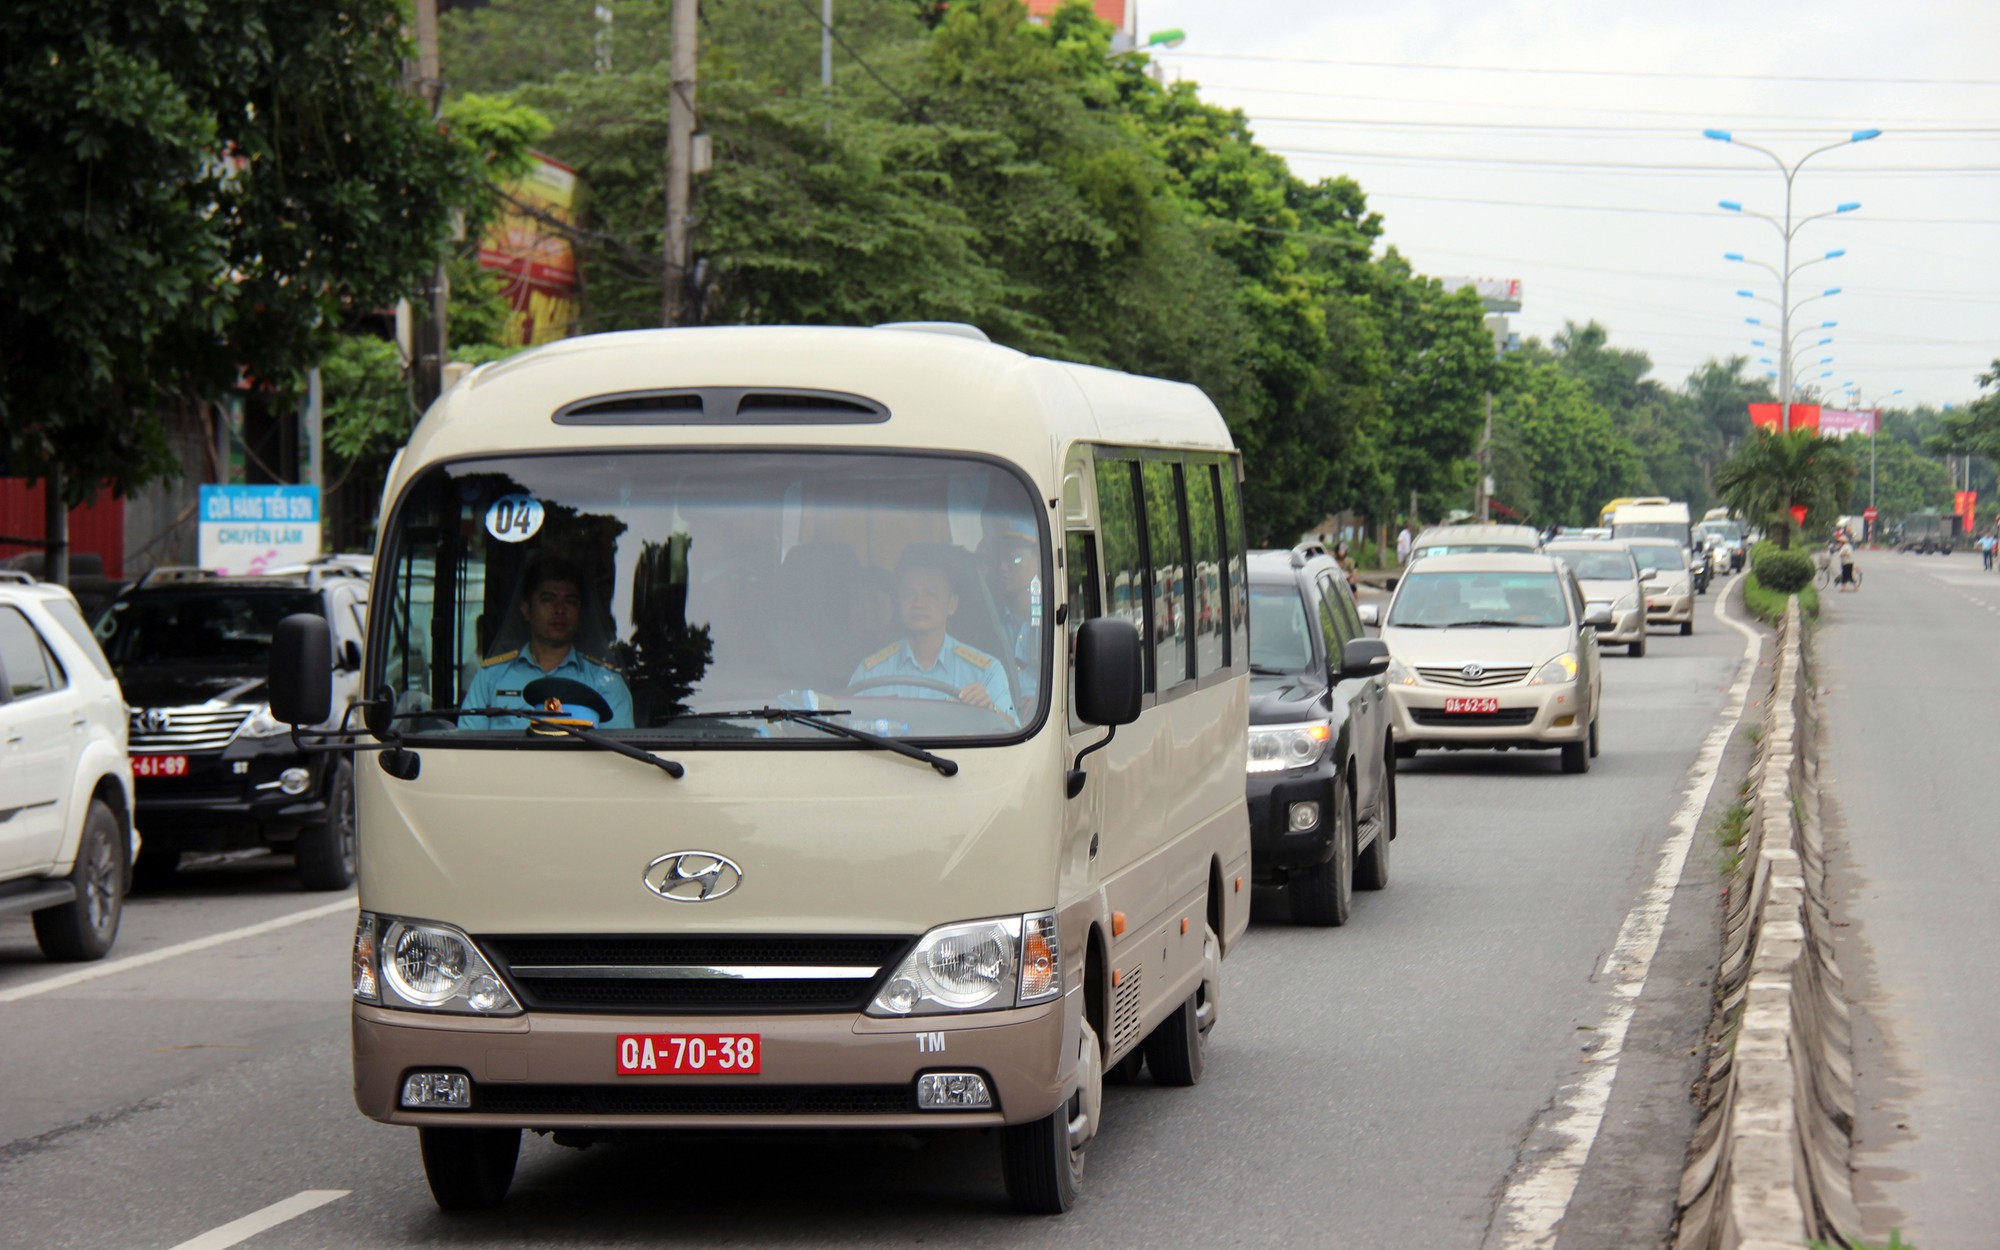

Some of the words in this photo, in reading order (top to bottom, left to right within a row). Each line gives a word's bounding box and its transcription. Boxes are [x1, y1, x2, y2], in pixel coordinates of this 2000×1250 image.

[495, 500, 530, 534] 04
[621, 1037, 754, 1069] QA-70-38
[915, 1031, 946, 1053] TM
